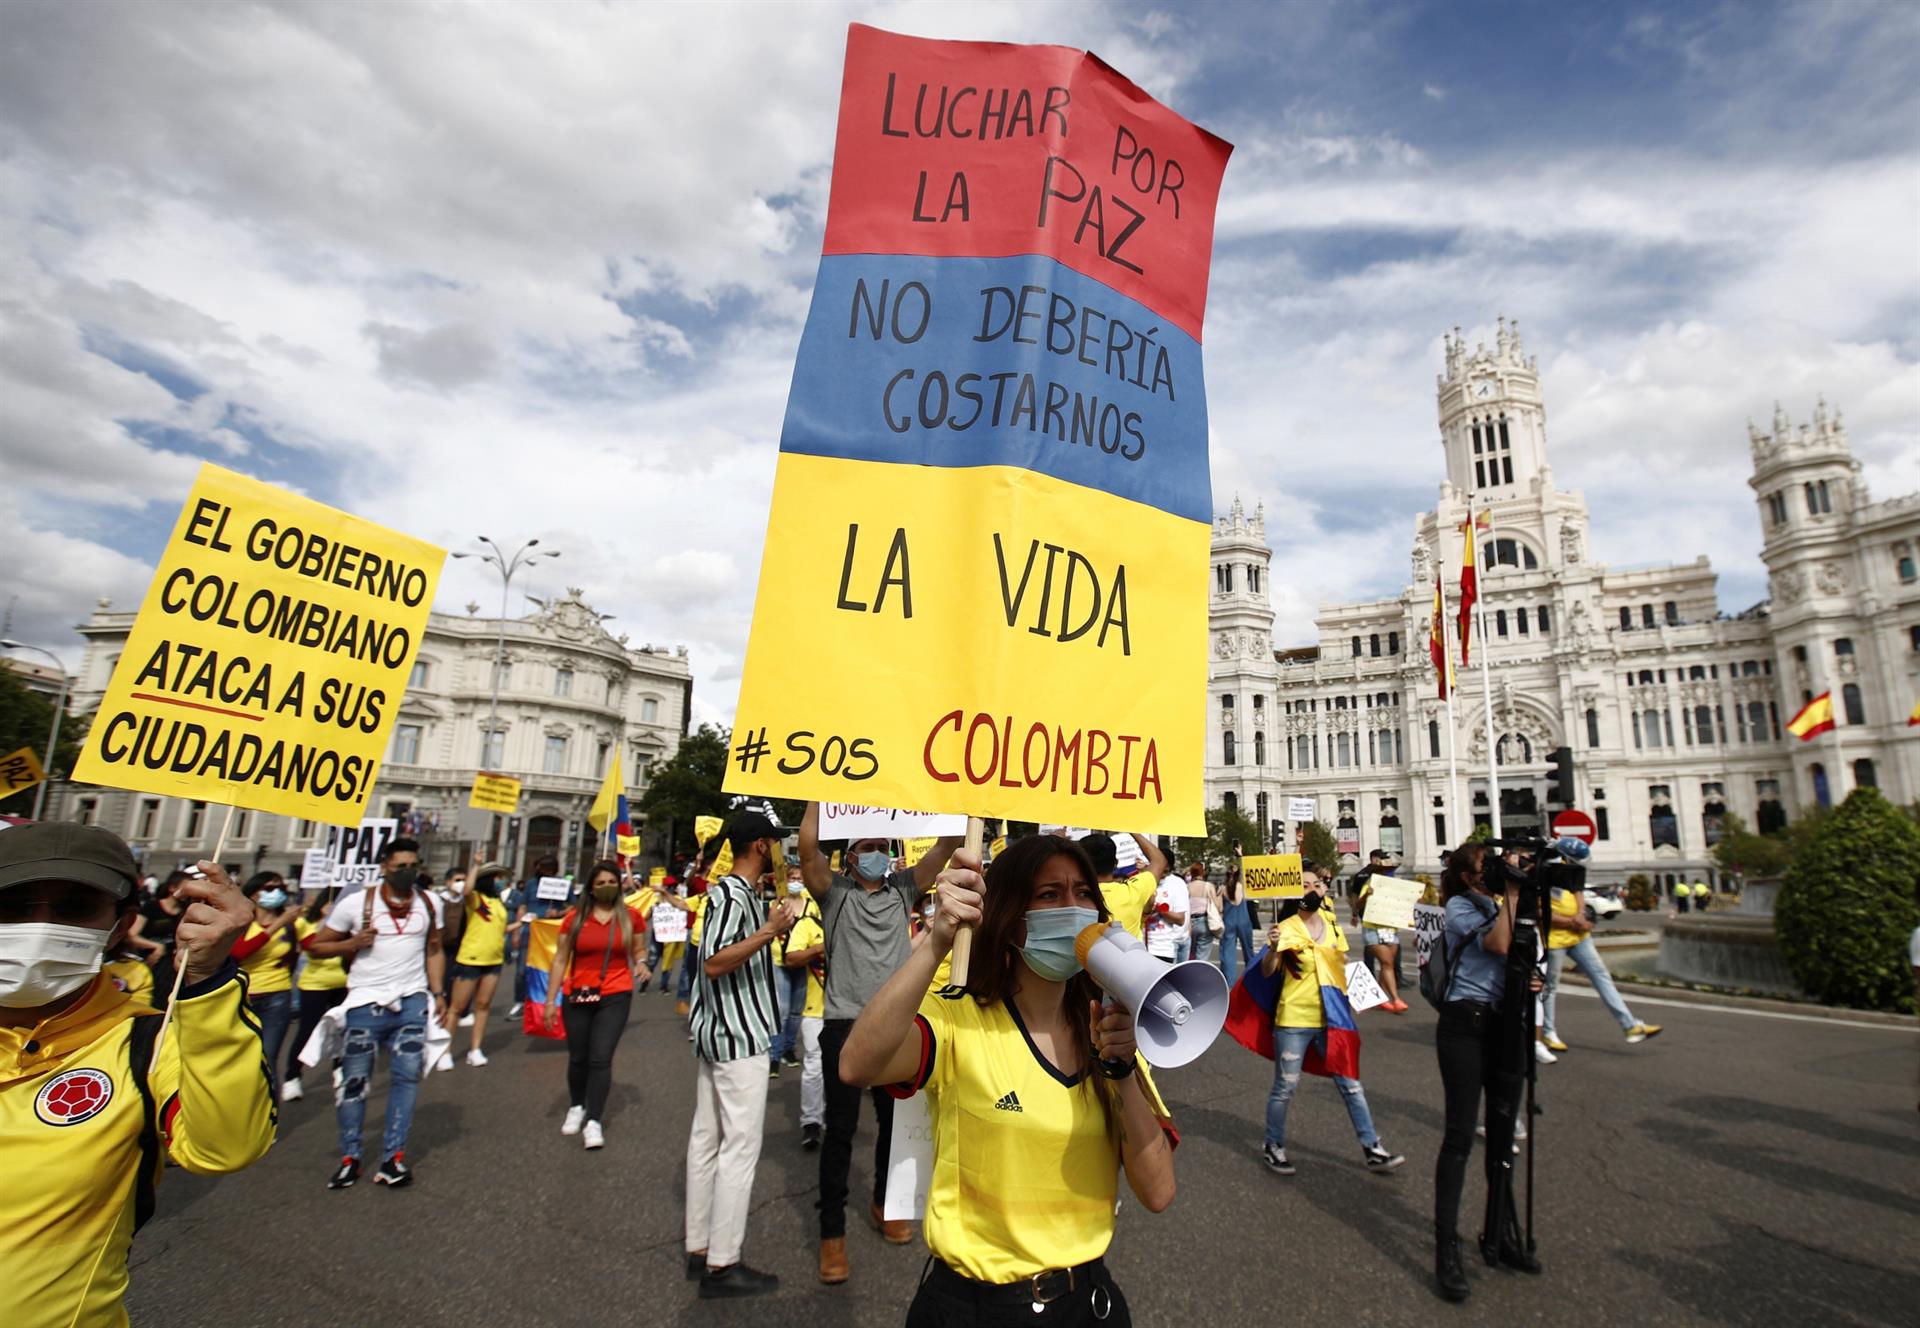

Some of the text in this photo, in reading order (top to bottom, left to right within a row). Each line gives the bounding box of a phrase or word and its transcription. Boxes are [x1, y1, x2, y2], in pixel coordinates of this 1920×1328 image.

[882, 72, 1185, 219] LUCHAR POR
[912, 156, 1146, 275] LA PAZ
[848, 278, 1175, 401] NO DEBERÍA
[883, 368, 1146, 461] COSTARNOS
[184, 498, 427, 607] EL GOBIERNO
[836, 523, 1131, 656] LA VIDA
[161, 568, 410, 669] COLOMBIANO
[134, 640, 386, 734] ATACA A SUS
[101, 712, 374, 803] CIUDADANOS!
[923, 709, 1163, 804] COLOMBIA
[1245, 866, 1302, 889] #SOSColombia
[995, 1103, 1023, 1113] adidas
